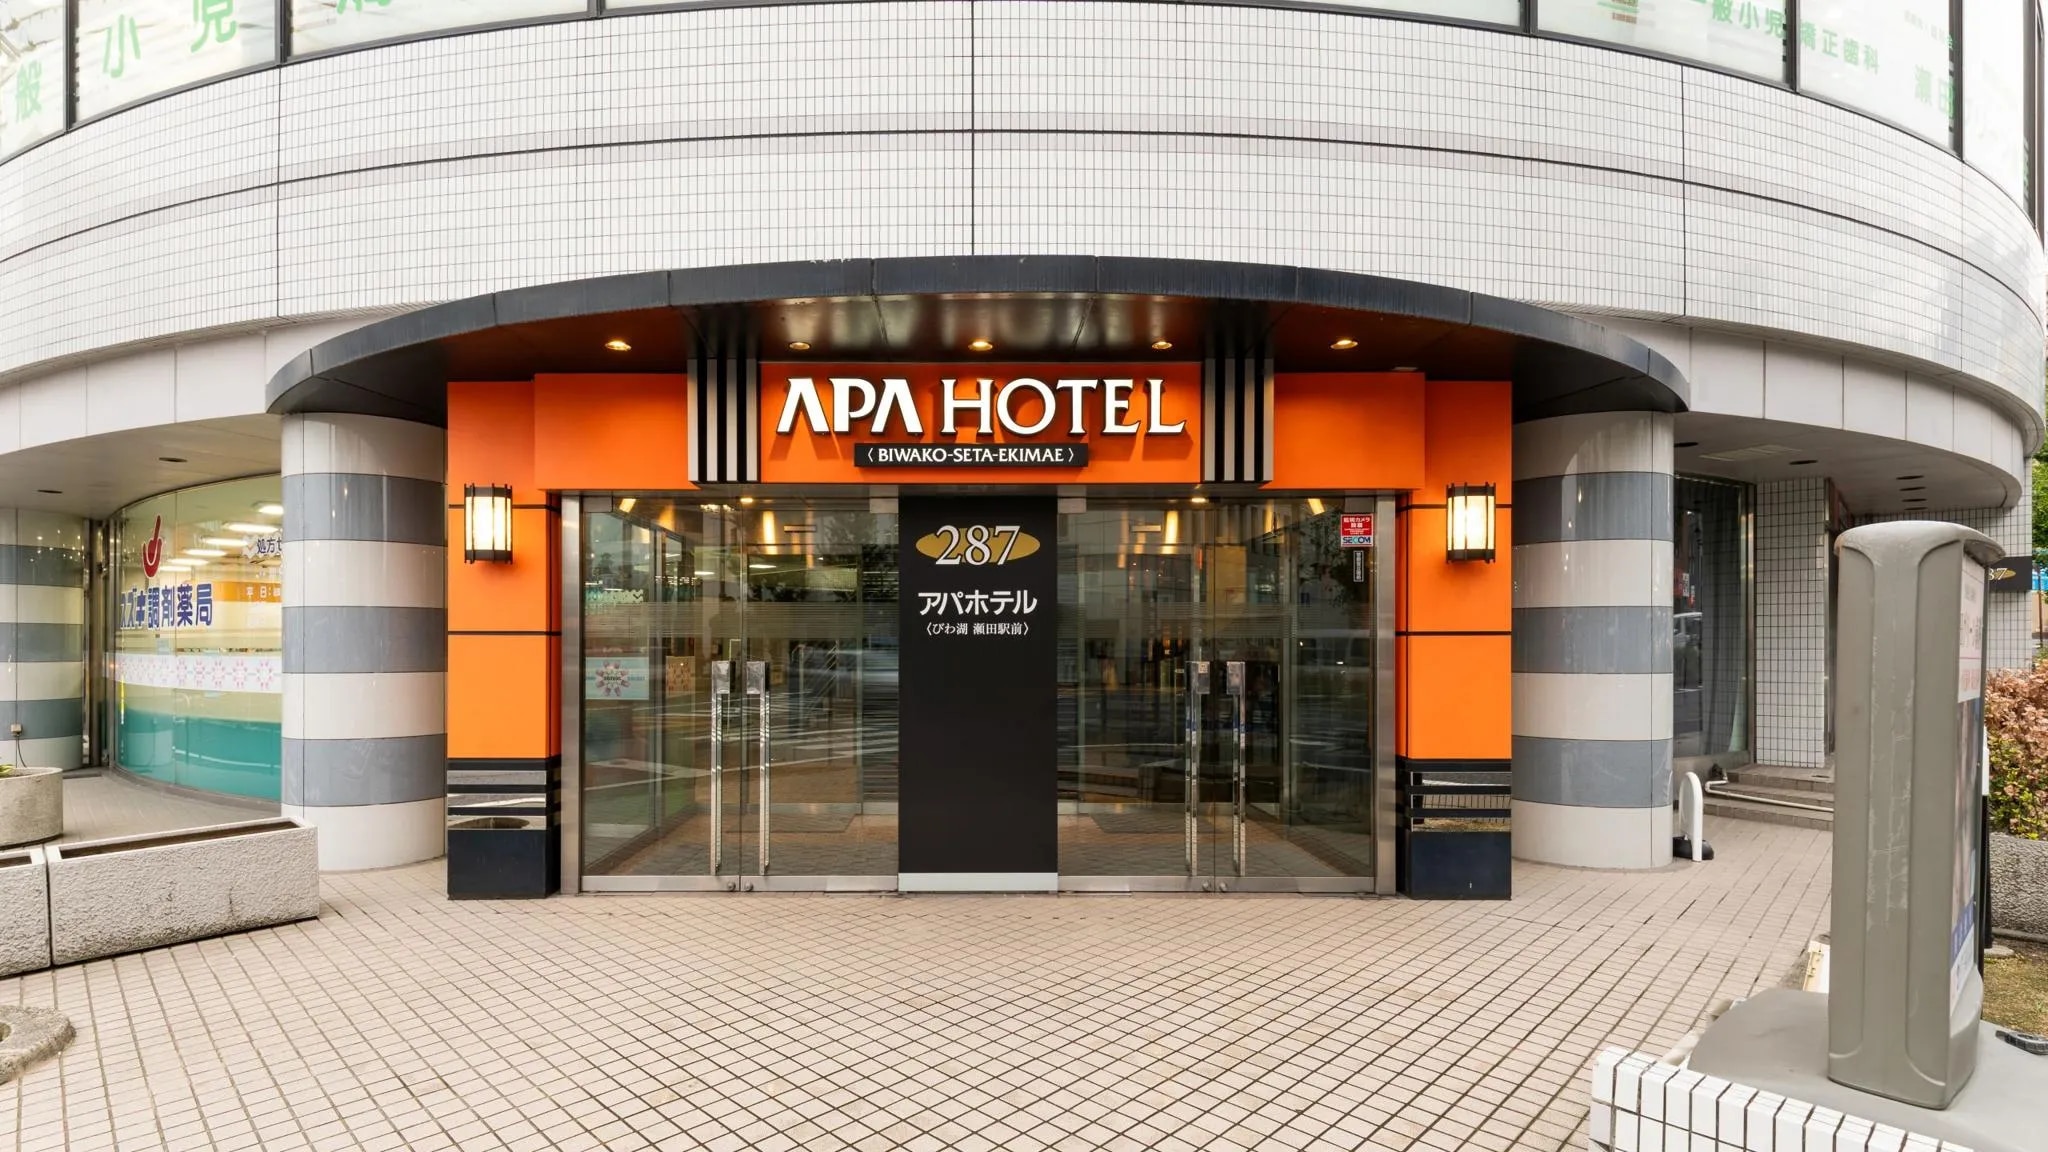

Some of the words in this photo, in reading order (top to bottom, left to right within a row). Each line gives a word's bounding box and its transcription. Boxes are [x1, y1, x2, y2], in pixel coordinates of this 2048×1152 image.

[776, 377, 924, 434] APA
[941, 377, 1188, 435] HOTEL
[935, 524, 1021, 566] 287
[1342, 536, 1371, 544] SECOM
[120, 583, 213, 629] スズキ調剤薬局
[918, 589, 1038, 615] アパホテル
